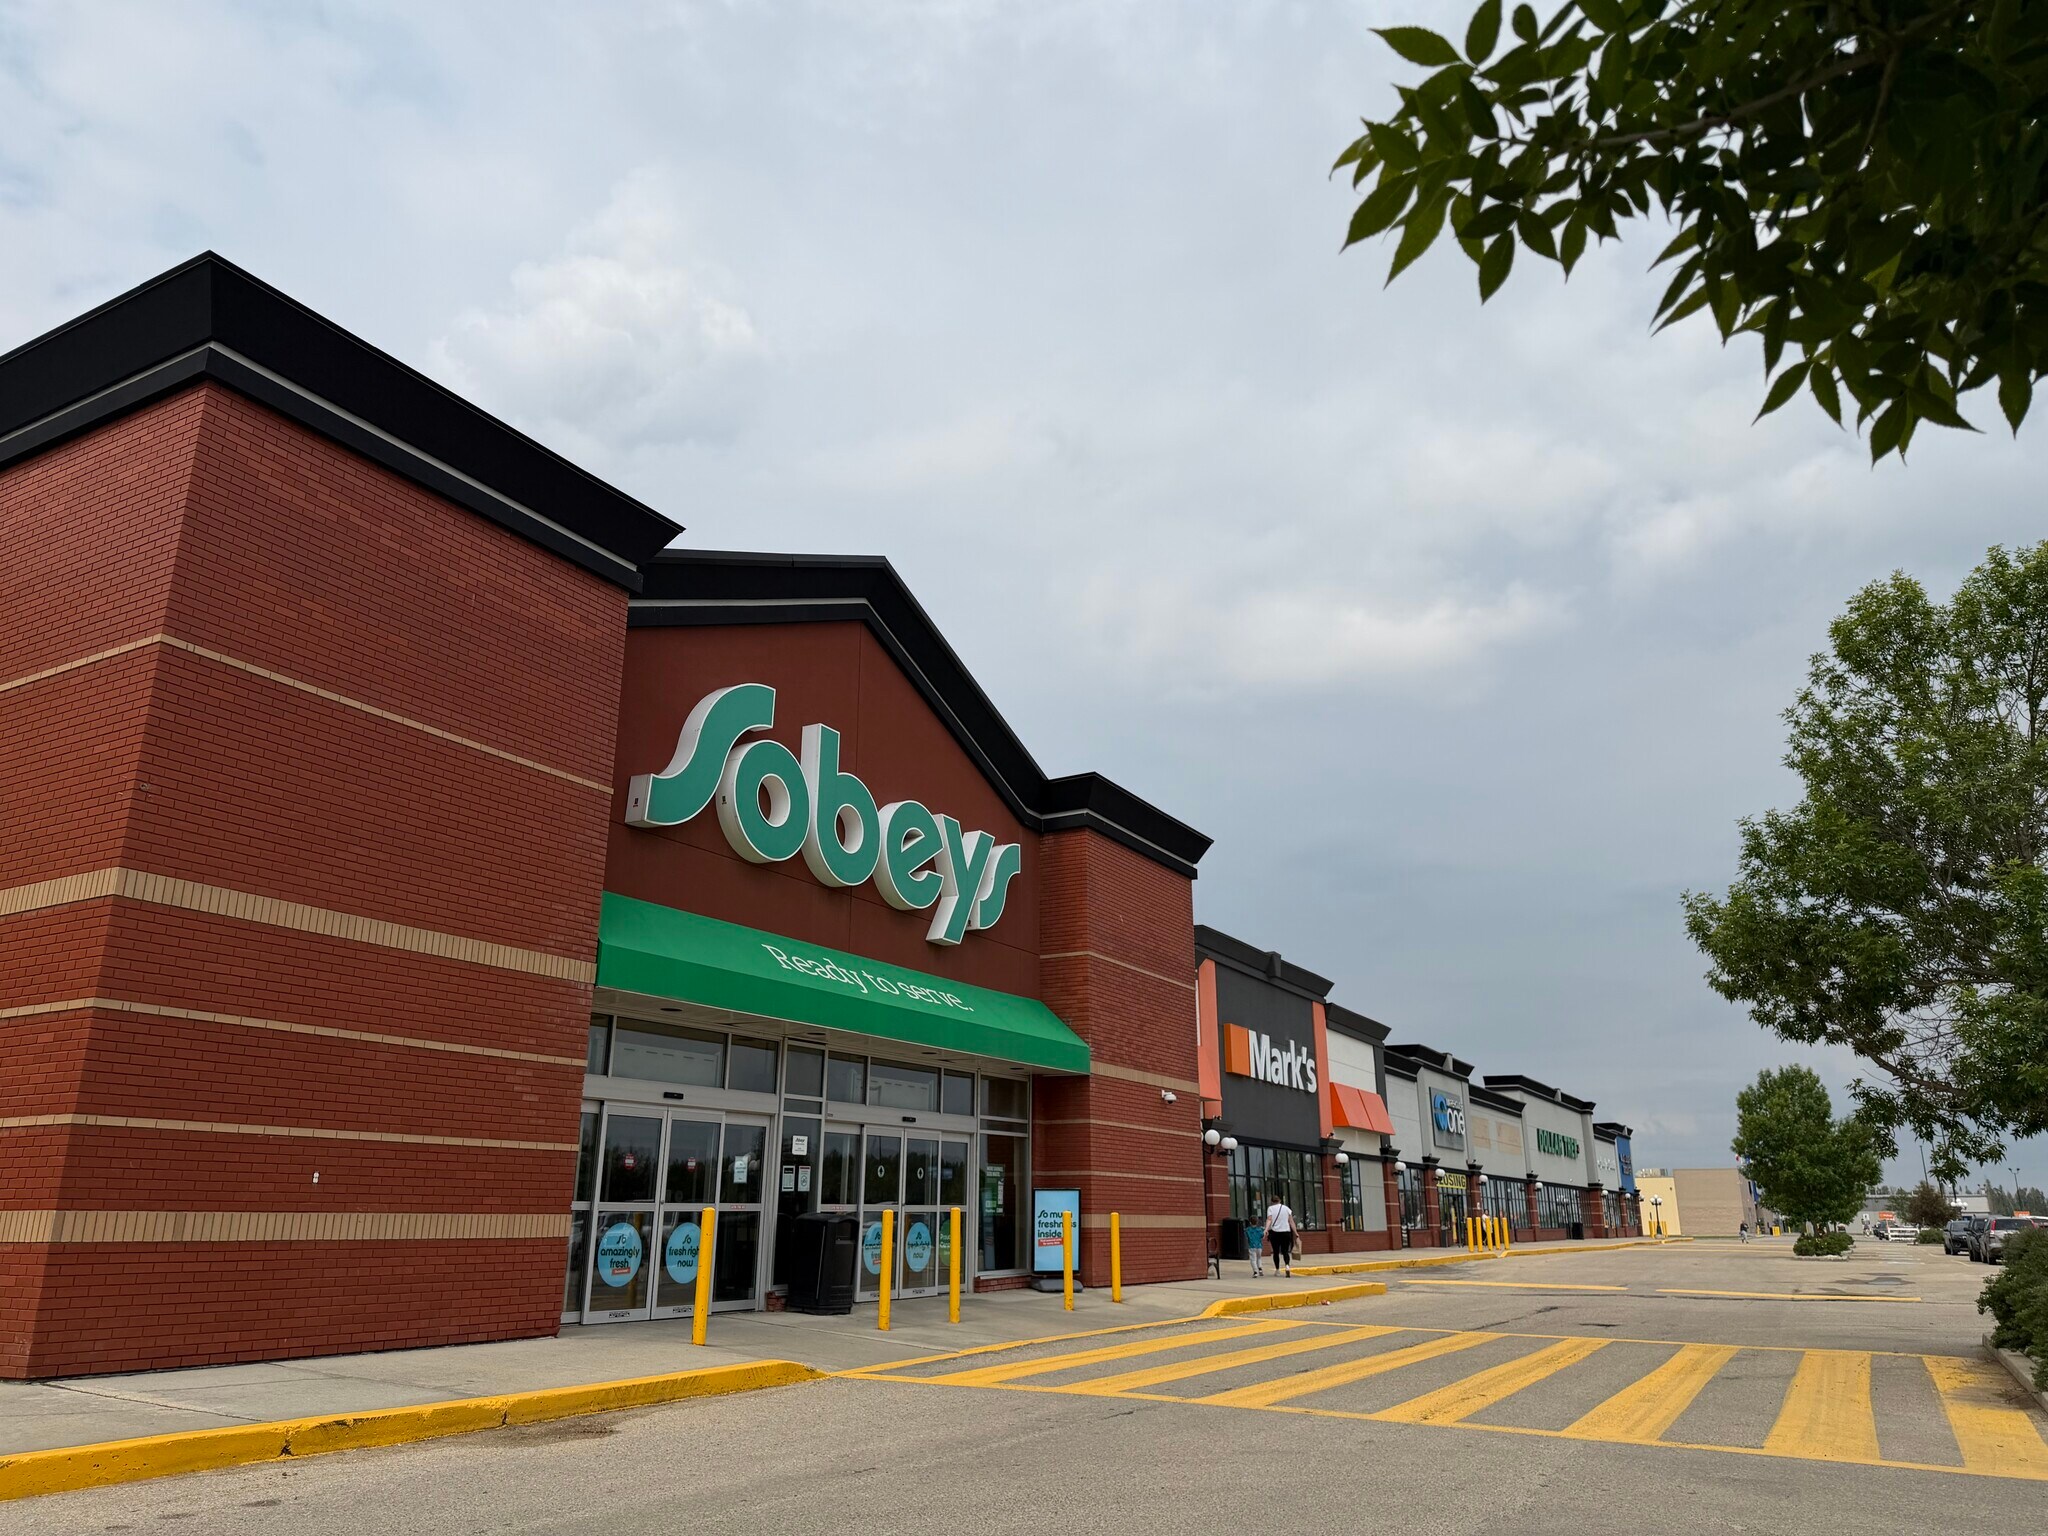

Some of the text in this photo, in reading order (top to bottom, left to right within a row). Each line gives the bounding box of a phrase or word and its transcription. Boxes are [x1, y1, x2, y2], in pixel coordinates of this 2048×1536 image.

[626, 683, 1021, 945] Sobeys
[761, 943, 974, 1012] Ready to serve.
[1248, 1029, 1317, 1094] Mark's
[1447, 1107, 1466, 1135] one
[1537, 1128, 1563, 1156] DOLLAR
[1038, 1210, 1073, 1218] So mu
[1038, 1220, 1077, 1228] freshns
[682, 1234, 692, 1244] So
[1038, 1230, 1062, 1238] inside
[600, 1247, 640, 1259] amazingly
[668, 1246, 687, 1256] fresh
[609, 1258, 629, 1269] fresh
